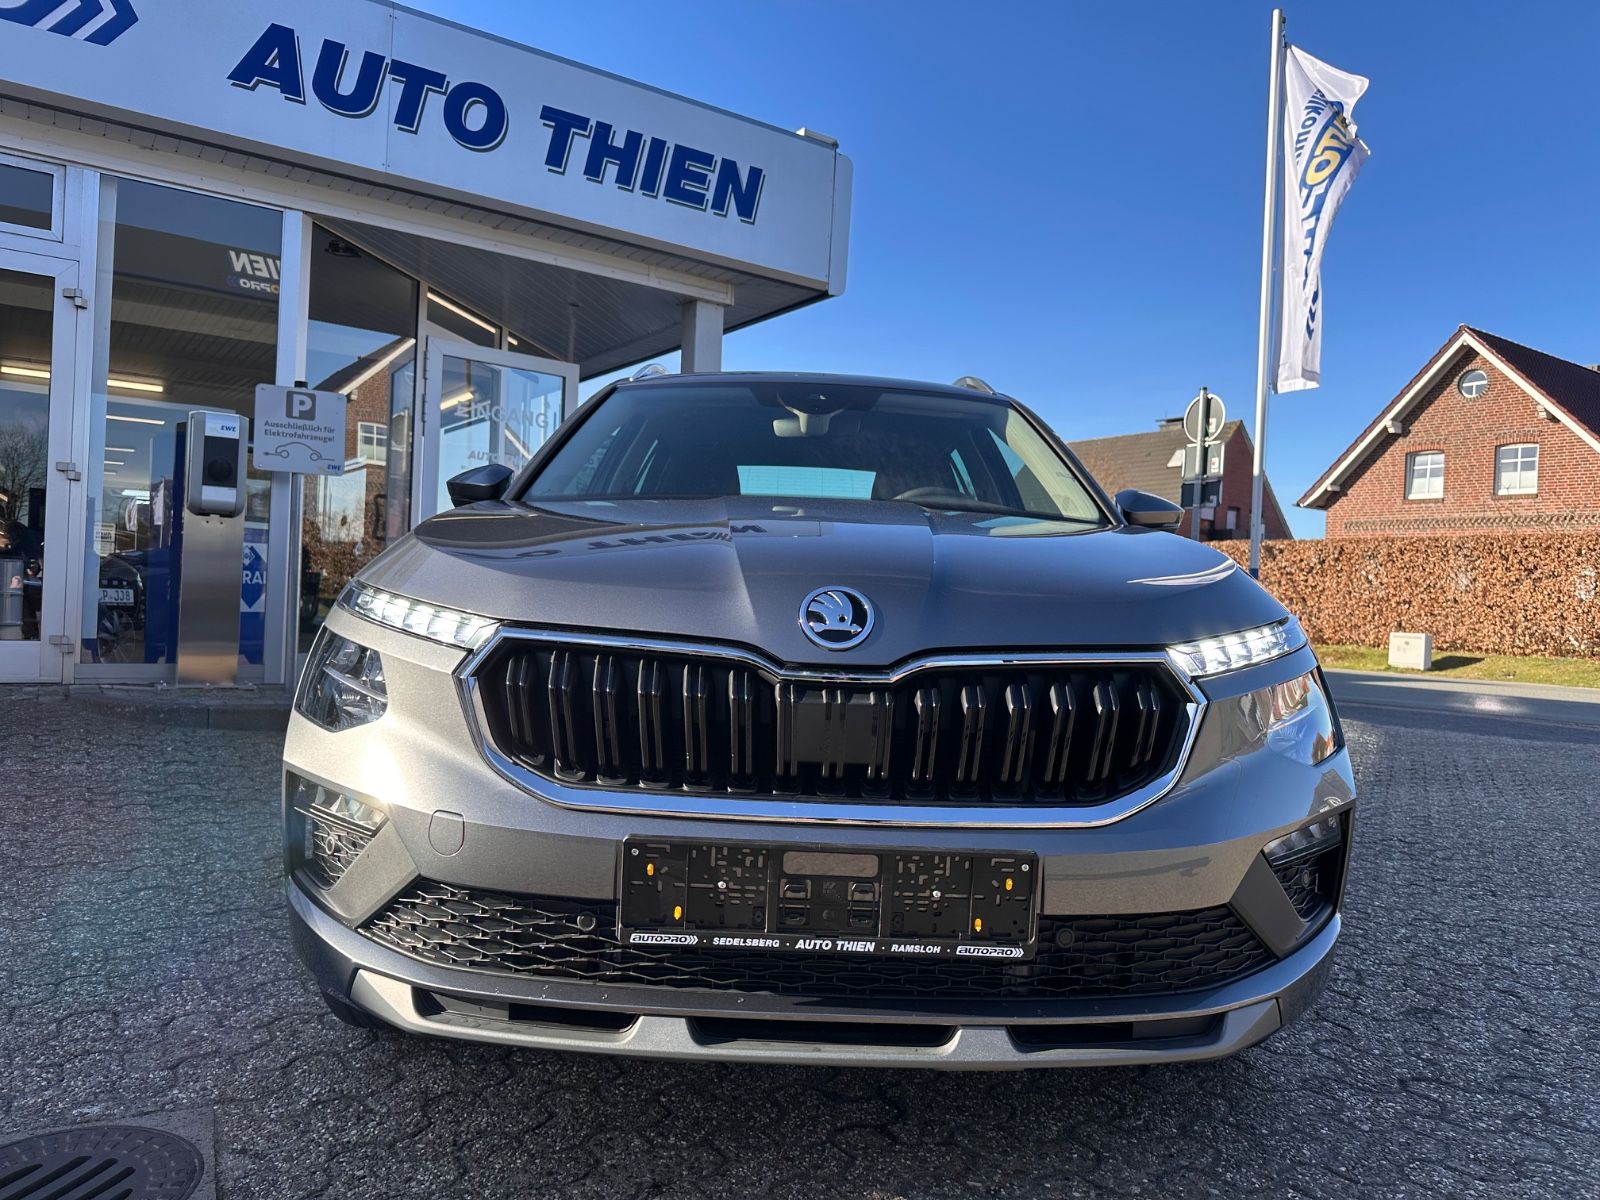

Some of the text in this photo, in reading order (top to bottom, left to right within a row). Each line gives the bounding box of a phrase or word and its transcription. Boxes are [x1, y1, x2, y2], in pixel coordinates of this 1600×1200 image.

[226, 22, 765, 225] AUTO THIEN
[292, 393, 313, 418] P
[455, 399, 548, 428] EINGANG
[221, 424, 237, 432] EWE
[264, 420, 336, 434] Ausschließlich für
[264, 429, 335, 444] Elektrofahrzeuge!
[326, 463, 342, 471] EWE
[712, 937, 780, 948] SEDELSBERG
[795, 939, 832, 951] AUTO
[836, 940, 876, 952] THIEN
[891, 943, 941, 954] RAMSLOH
